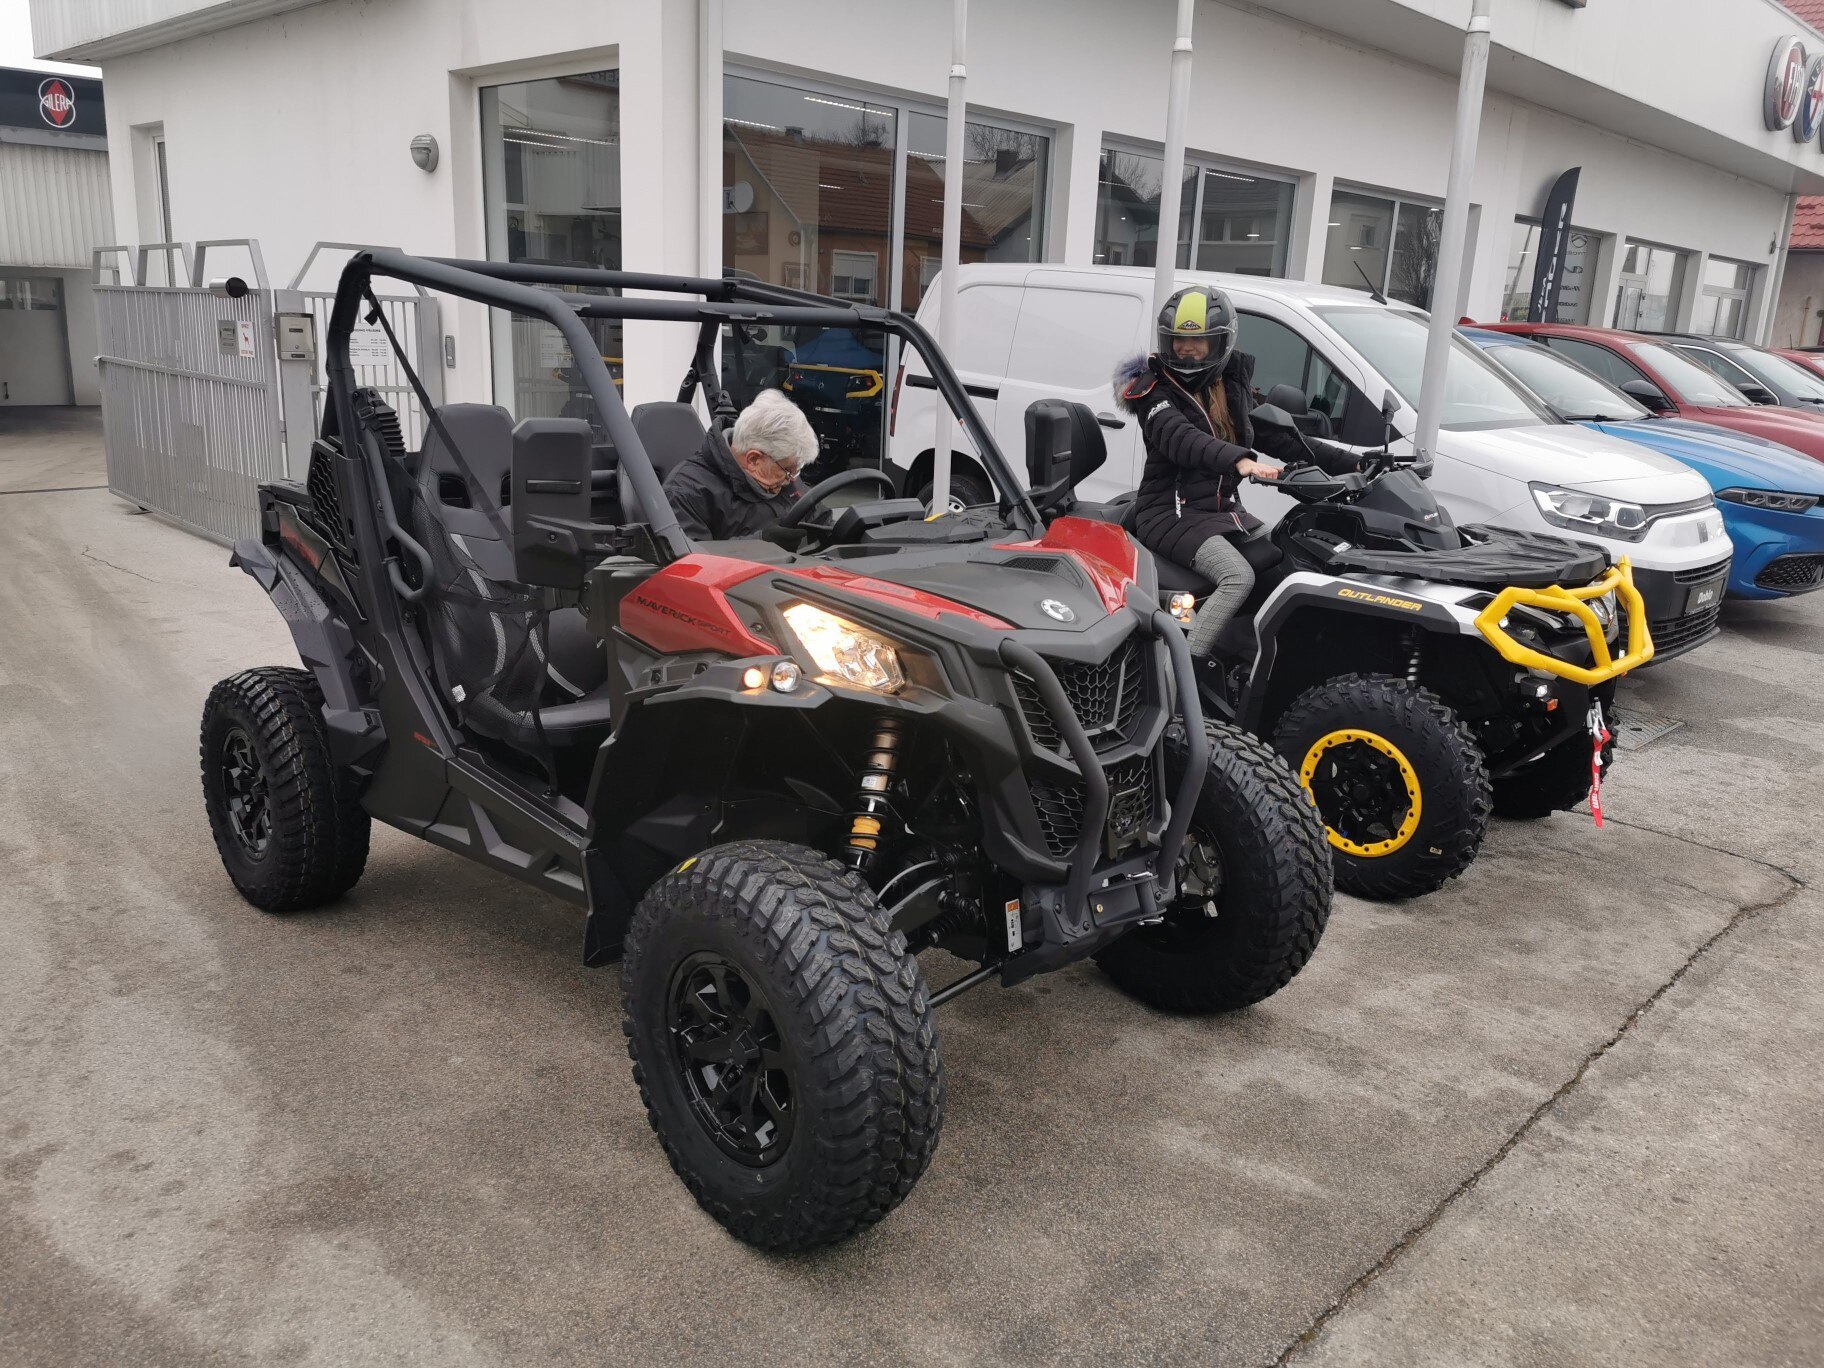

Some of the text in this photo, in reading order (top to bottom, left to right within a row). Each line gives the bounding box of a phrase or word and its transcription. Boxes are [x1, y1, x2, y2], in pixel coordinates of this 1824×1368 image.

[1783, 61, 1804, 104] FIAT
[42, 93, 71, 112] GILERA
[637, 596, 732, 636] MAVERICK SPORT
[1337, 588, 1423, 612] OUTLANDER
